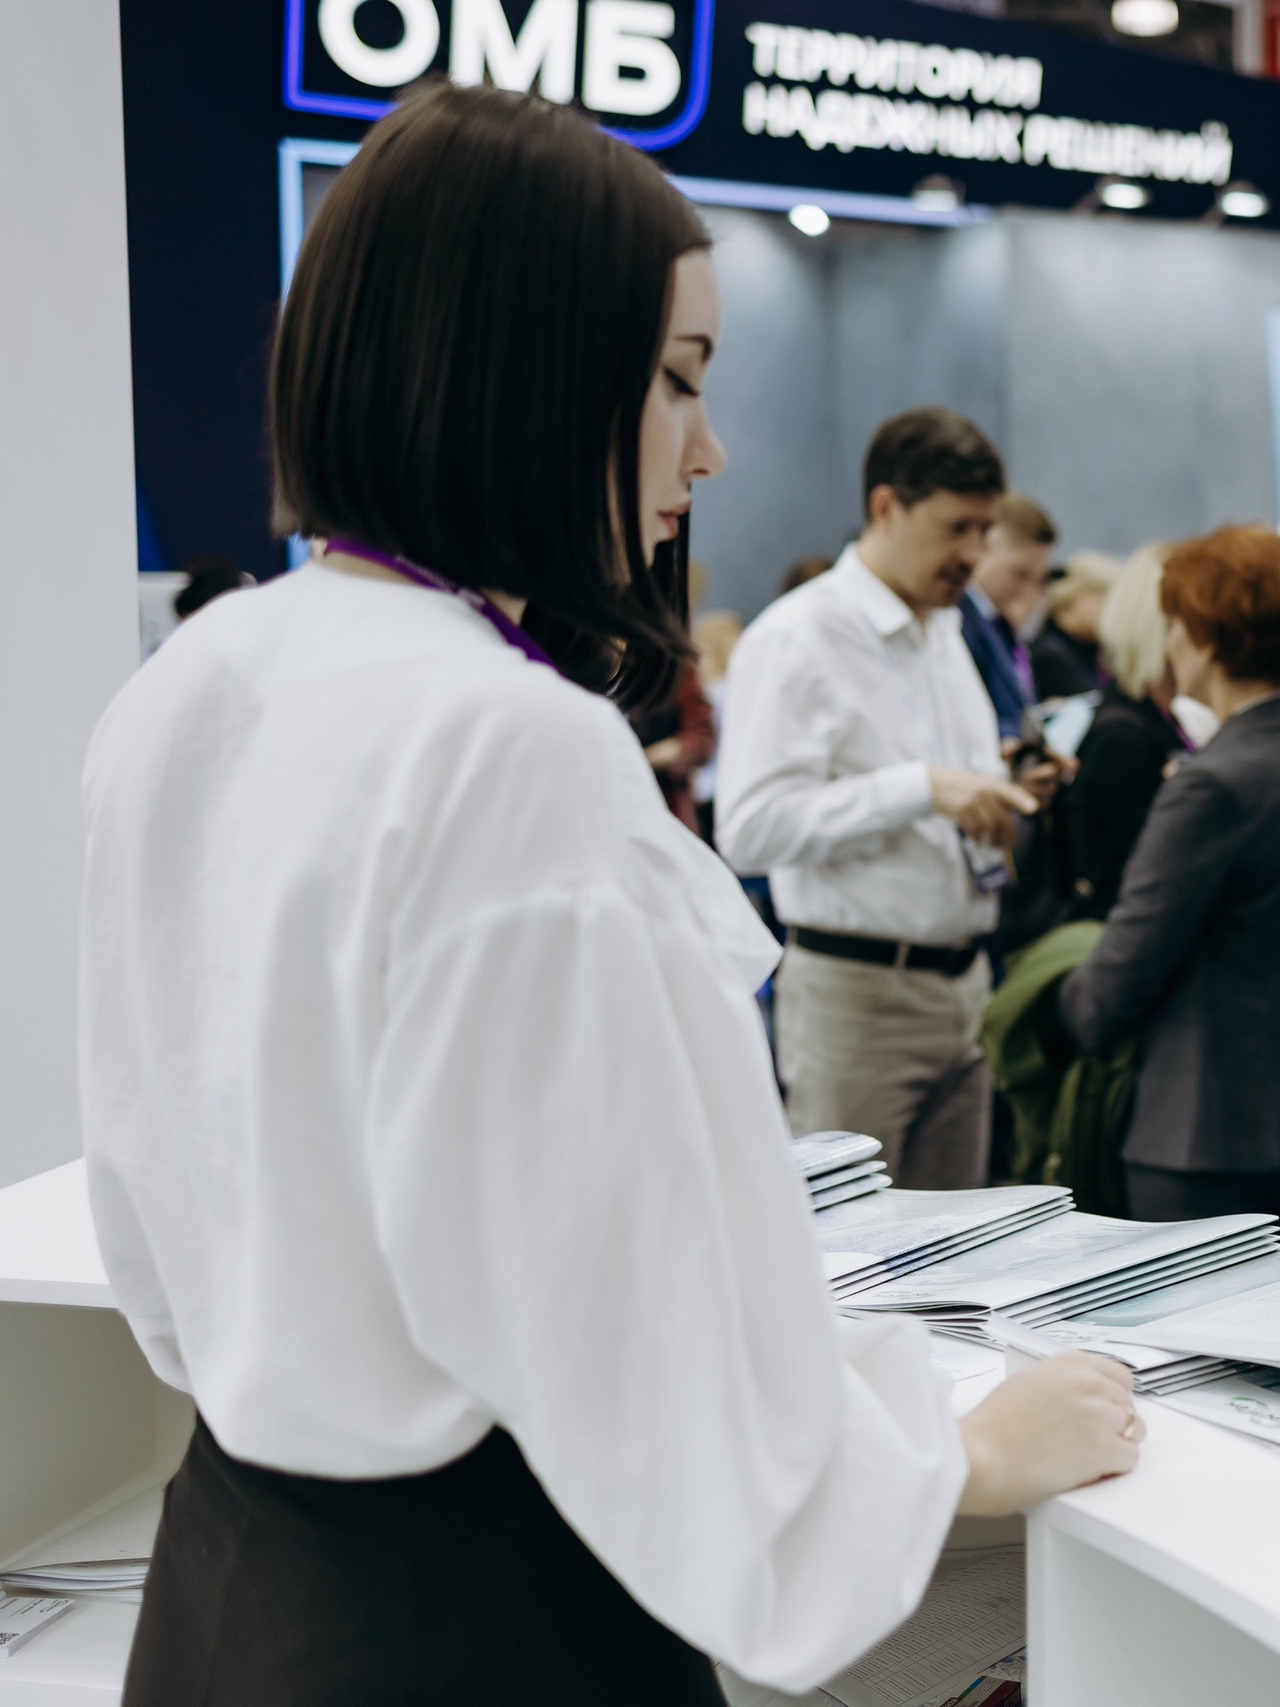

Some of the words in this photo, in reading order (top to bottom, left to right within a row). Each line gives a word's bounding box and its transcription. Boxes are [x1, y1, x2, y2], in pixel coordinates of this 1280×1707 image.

[318, 0, 681, 115] ОМБ
[746, 21, 1043, 109] ТЕРРИТОРИЯ
[742, 81, 1023, 164] НАДЕЖНЫХ
[1022, 114, 1233, 186] РЕШЕНИЙ
